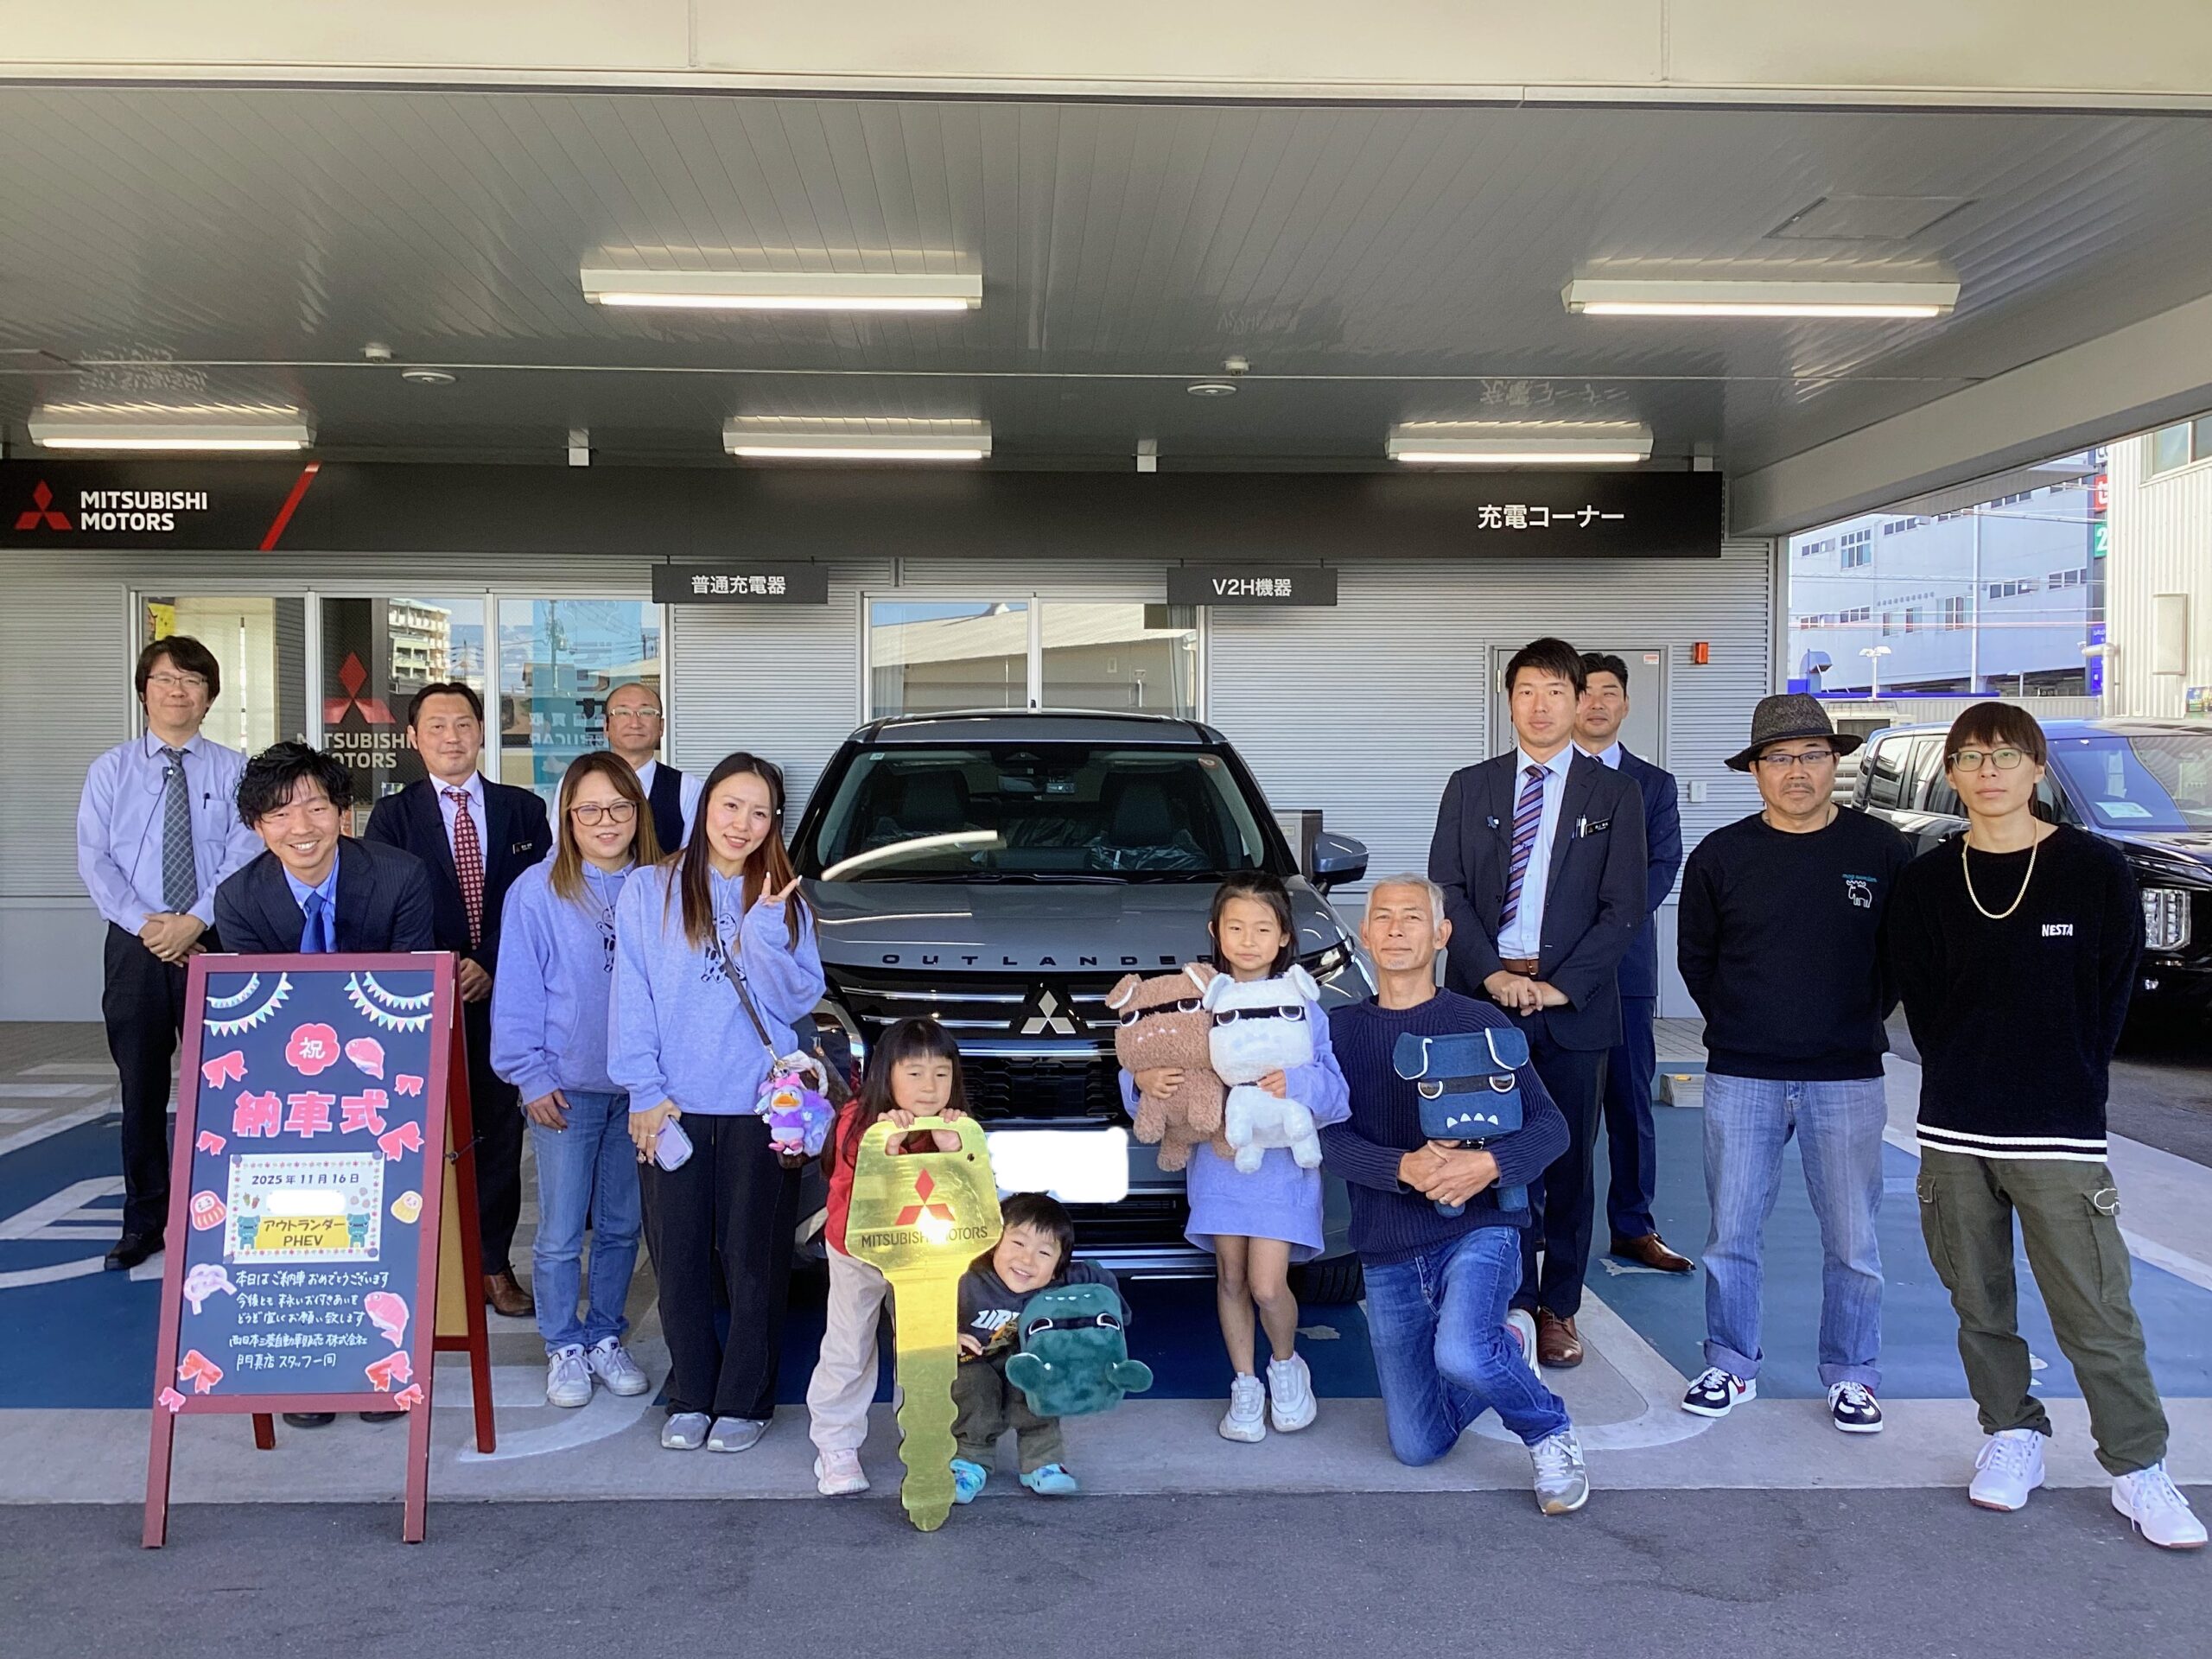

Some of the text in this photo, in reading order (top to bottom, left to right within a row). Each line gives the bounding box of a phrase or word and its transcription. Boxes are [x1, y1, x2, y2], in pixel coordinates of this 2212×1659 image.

[80, 491, 207, 510] MITSUBISHI
[80, 512, 175, 531] MOTORS
[1478, 504, 1624, 530] 充電コーナー
[691, 575, 786, 594] 普通充電器
[1211, 578, 1292, 597] V2H機器
[2042, 924, 2073, 937] NESTA
[299, 1037, 326, 1059] 祝
[232, 1089, 389, 1138] 納車式
[264, 1218, 346, 1231] アウトランダー
[283, 1235, 323, 1247] PHEV
[861, 1230, 932, 1248] MITSUBISH
